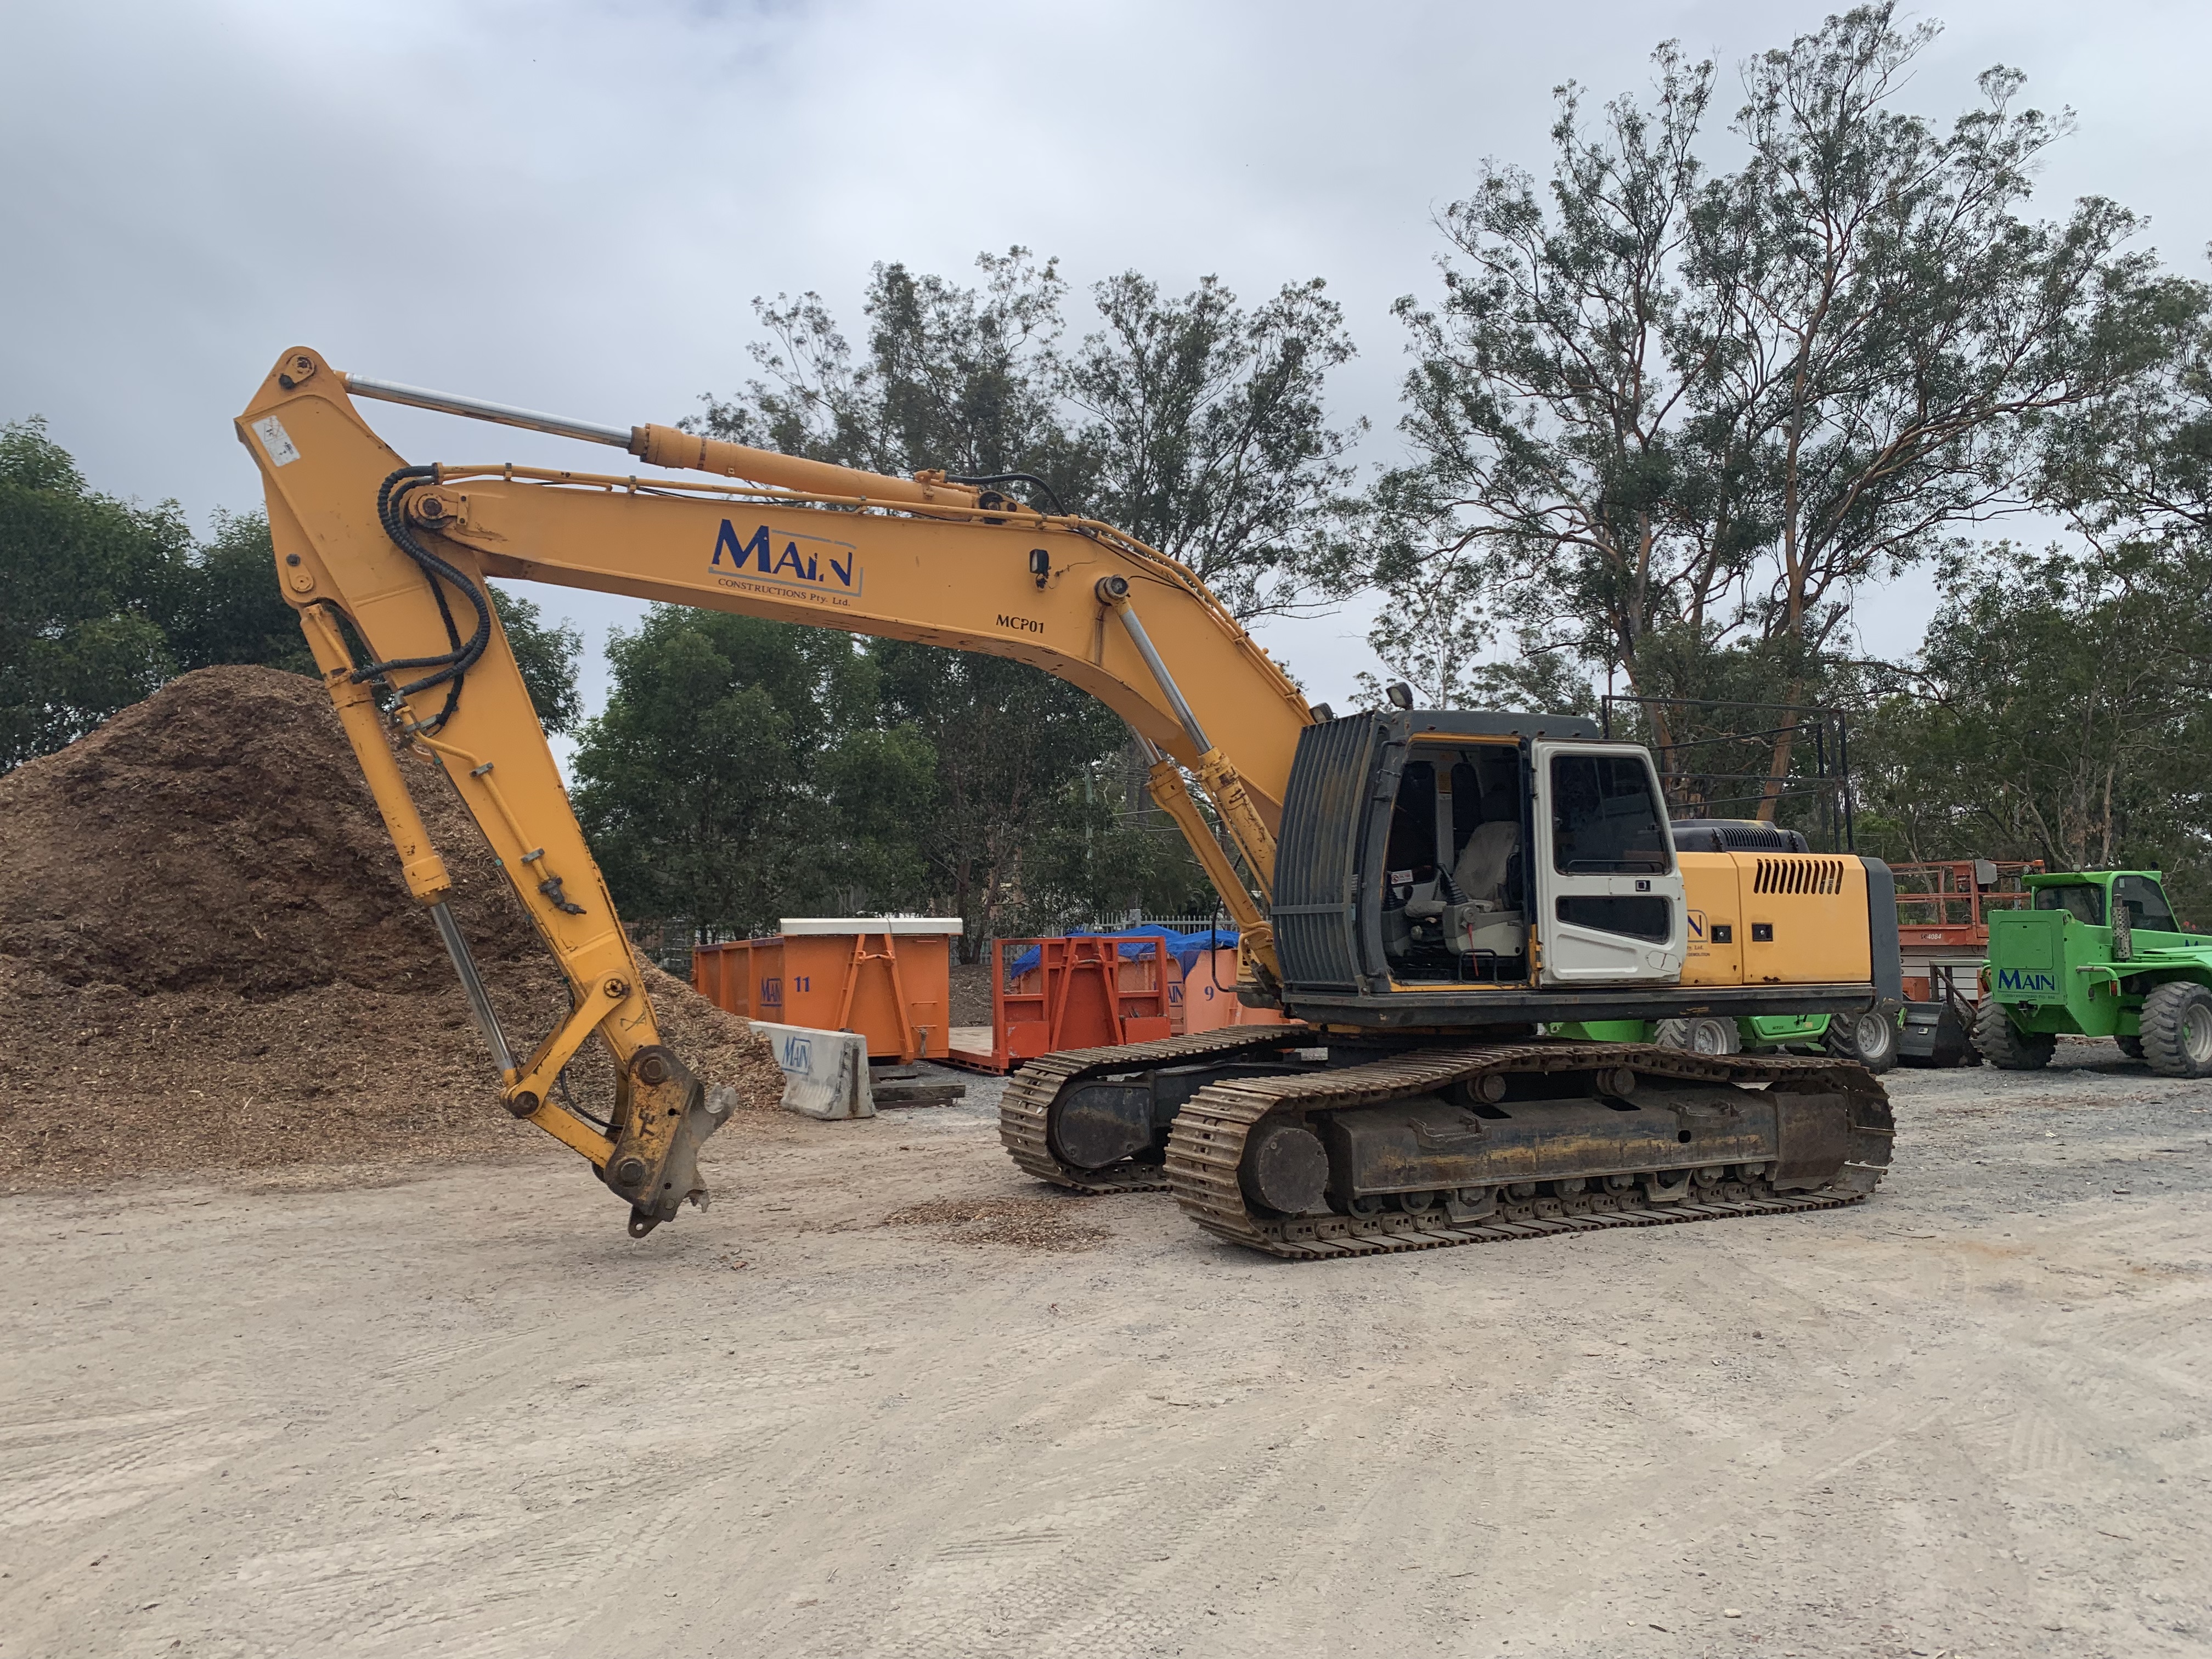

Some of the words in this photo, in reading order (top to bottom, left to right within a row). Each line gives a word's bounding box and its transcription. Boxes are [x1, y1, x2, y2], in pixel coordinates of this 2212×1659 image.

[718, 578, 806, 599] CONSTRUCTIONS
[810, 593, 828, 604] Pty.
[832, 597, 850, 606] Ltd.
[996, 614, 1044, 634] MCP01
[794, 977, 810, 992] 11
[1998, 968, 2055, 991] MAIN
[1204, 986, 1214, 1001] 9
